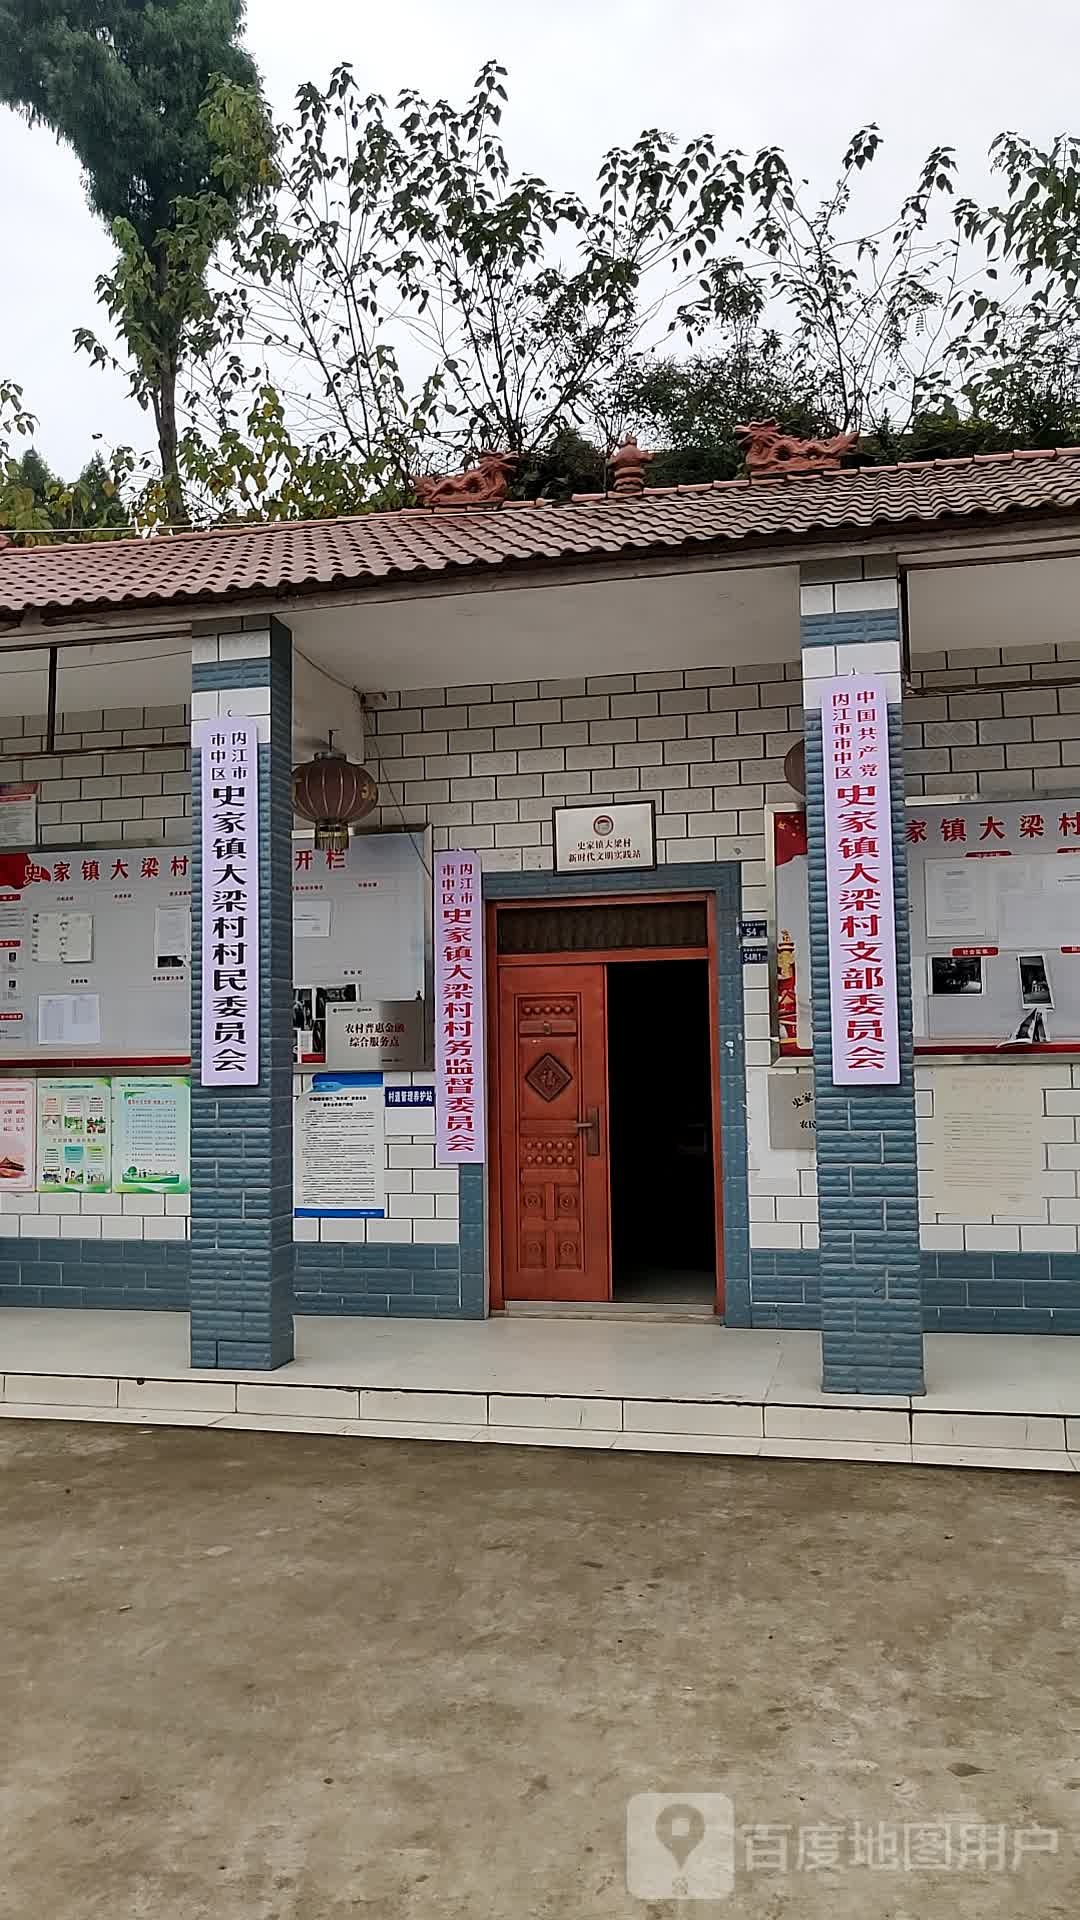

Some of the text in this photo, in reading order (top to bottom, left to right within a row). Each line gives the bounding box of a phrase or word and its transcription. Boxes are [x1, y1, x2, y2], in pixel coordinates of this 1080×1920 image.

[832, 693, 853, 779] 内江市市中区
[857, 690, 878, 777] 中国共产党
[210, 732, 227, 780] 市中区
[231, 731, 249, 779] 内江市
[568, 850, 641, 863] 新时代文明实践站
[577, 838, 631, 850] 史家镇大梁村
[24, 848, 346, 885] 史家镇大梁村 开栏
[441, 863, 456, 905] 市中区
[460, 863, 473, 904] 内江市
[212, 785, 248, 1071] 史家镇大梁村村民委员会
[746, 927, 757, 936] 54
[836, 784, 887, 1069] 史家镇大梁村支部委员会
[345, 1022, 405, 1034] 农村普惠金融
[349, 1036, 400, 1048] 综合服务点
[443, 908, 476, 1151] 史家镇大梁村村务监督委员会
